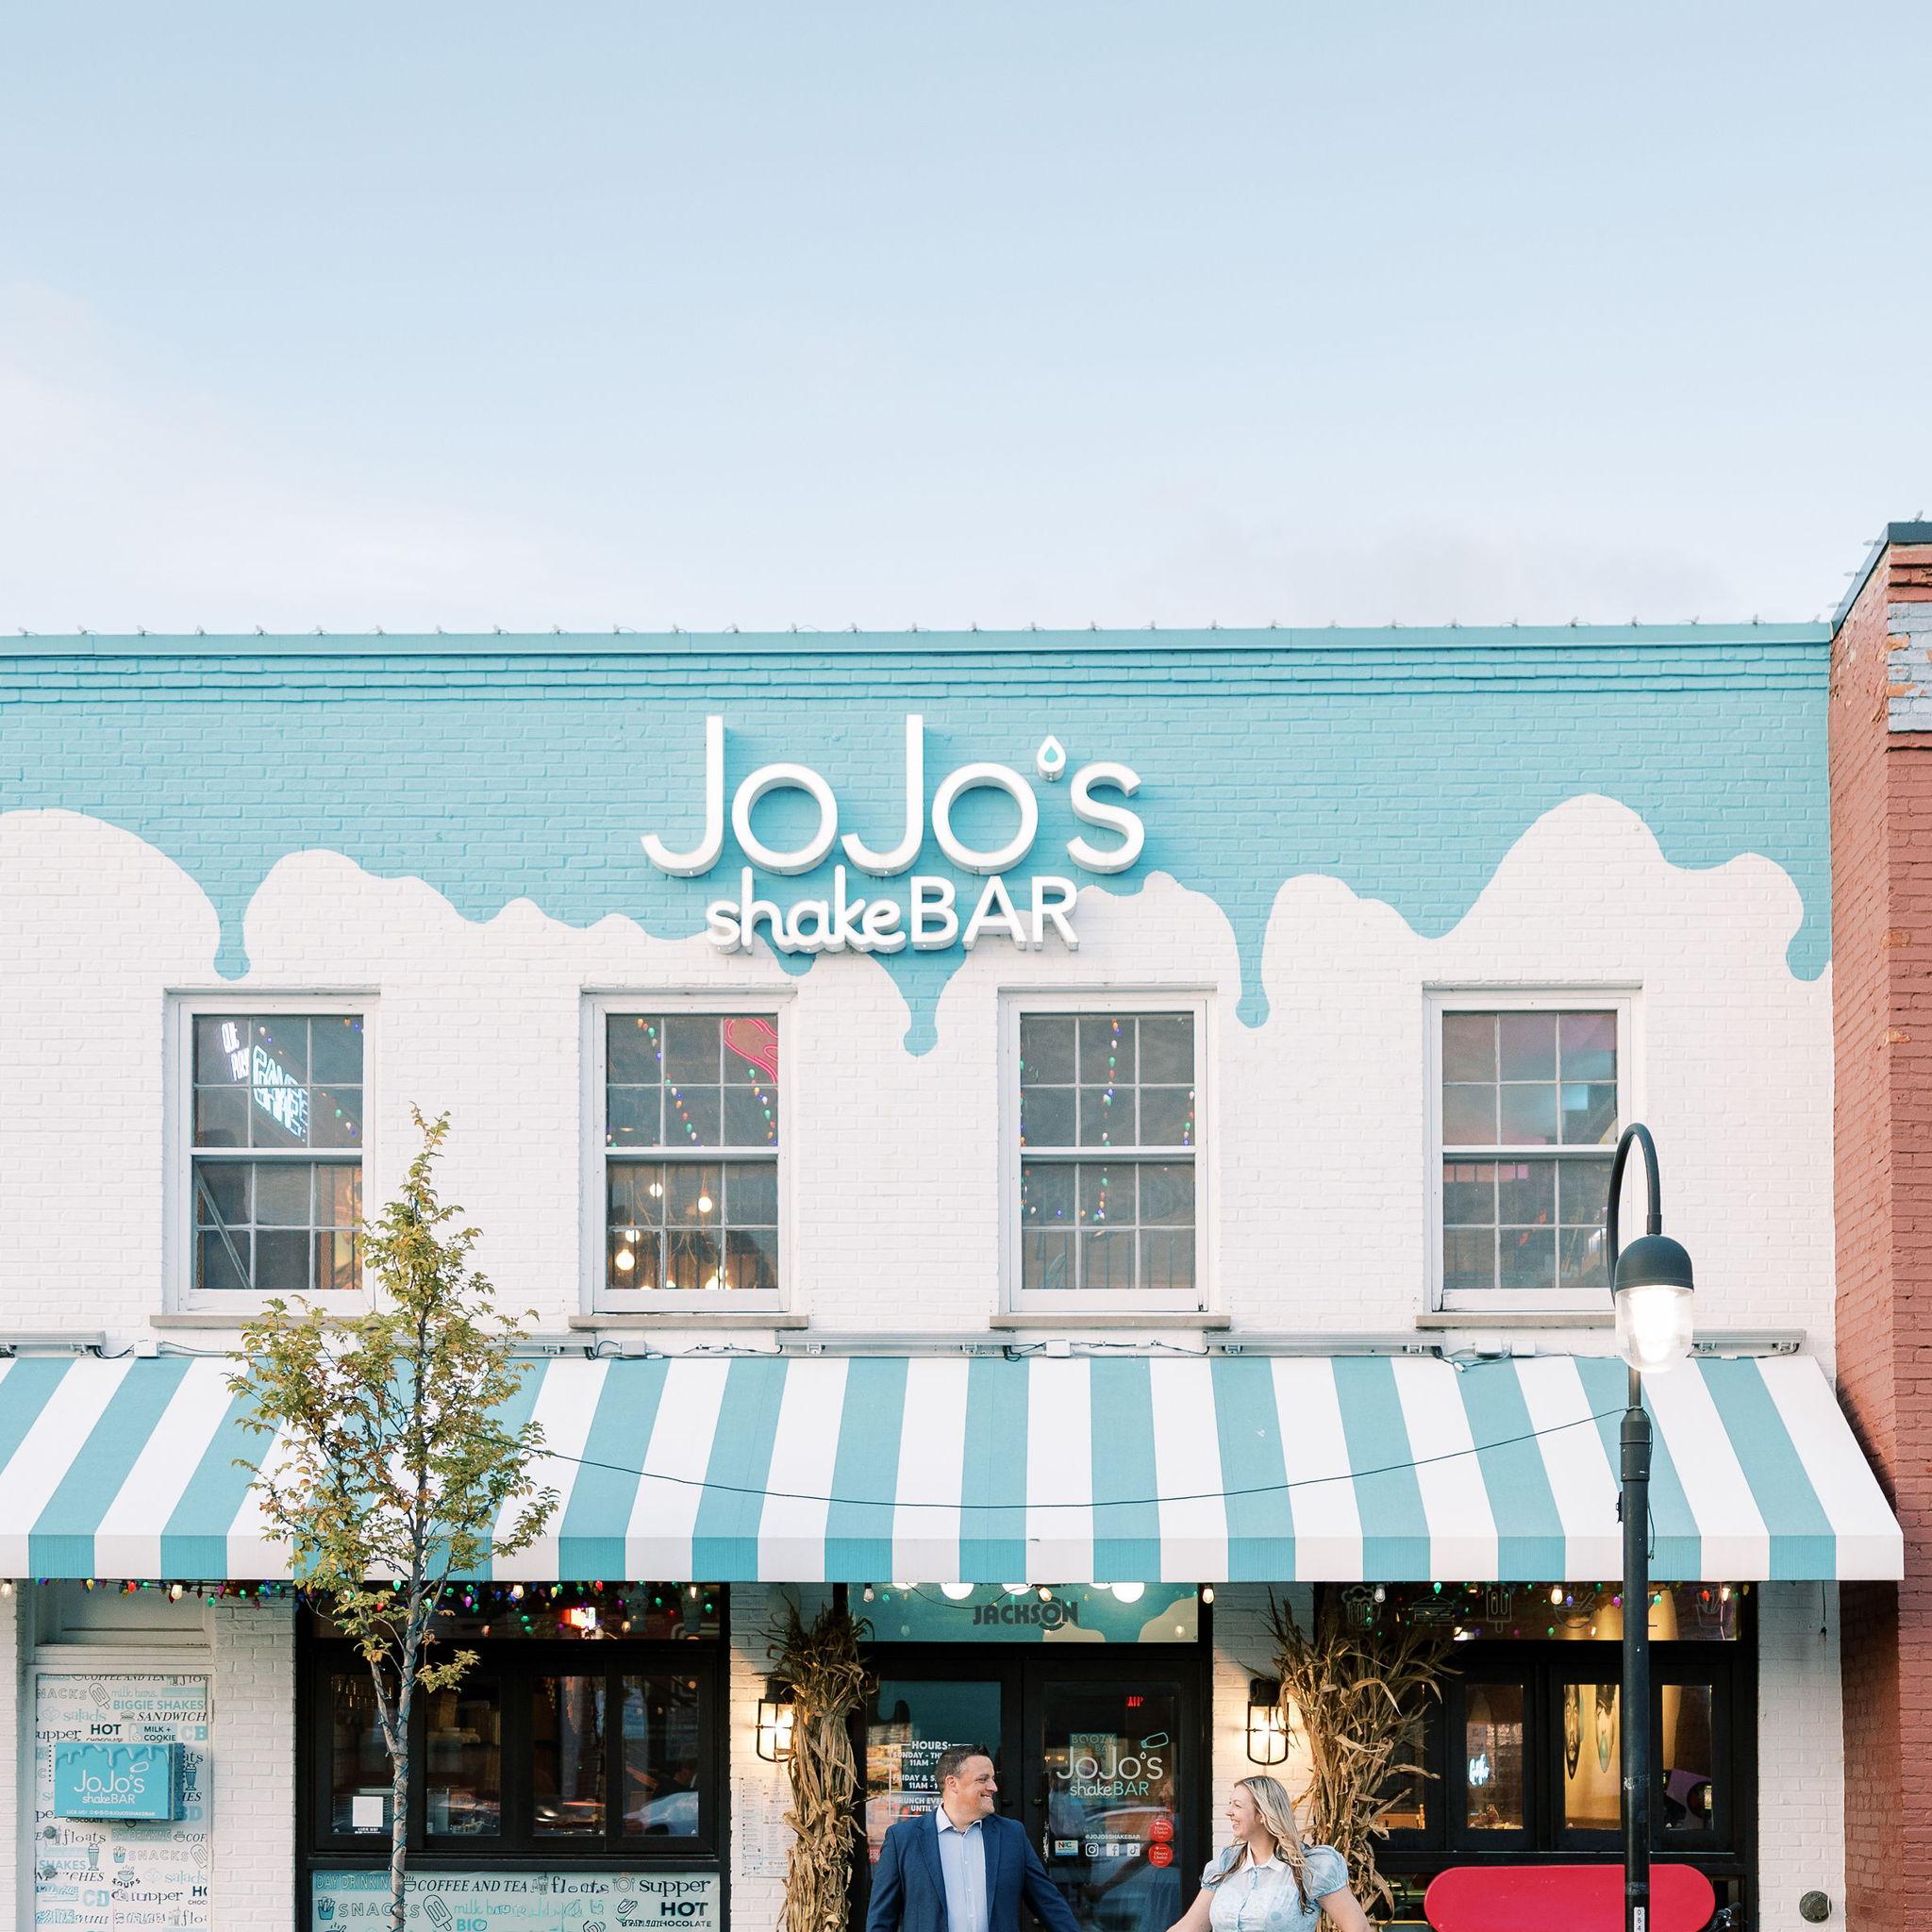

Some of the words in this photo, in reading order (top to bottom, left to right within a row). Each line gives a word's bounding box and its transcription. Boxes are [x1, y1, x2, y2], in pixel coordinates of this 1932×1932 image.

[641, 714, 1145, 877] JoJo's
[705, 864, 1079, 956] shakeBAR
[973, 1596, 1078, 1630] JACKSON
[113, 1700, 154, 1709] BIGGIE
[157, 1700, 204, 1710] SHAKES
[62, 1708, 107, 1723] salads
[91, 1724, 122, 1735] HOT
[144, 1734, 176, 1742] COOKIE
[911, 1740, 948, 1750] HOURS
[1071, 1735, 1114, 1744] BOOZY
[1070, 1778, 1149, 1796] shakeBAR
[82, 1791, 137, 1804] shakeBAR
[62, 1828, 106, 1846] floats
[128, 1849, 190, 1862] SNACKS
[317, 1874, 339, 1889] DAY
[417, 1879, 470, 1892] COFFEE
[471, 1879, 501, 1892] AND
[504, 1879, 527, 1892] TEA
[639, 1878, 711, 1897] supper
[660, 1902, 708, 1917] HOT
